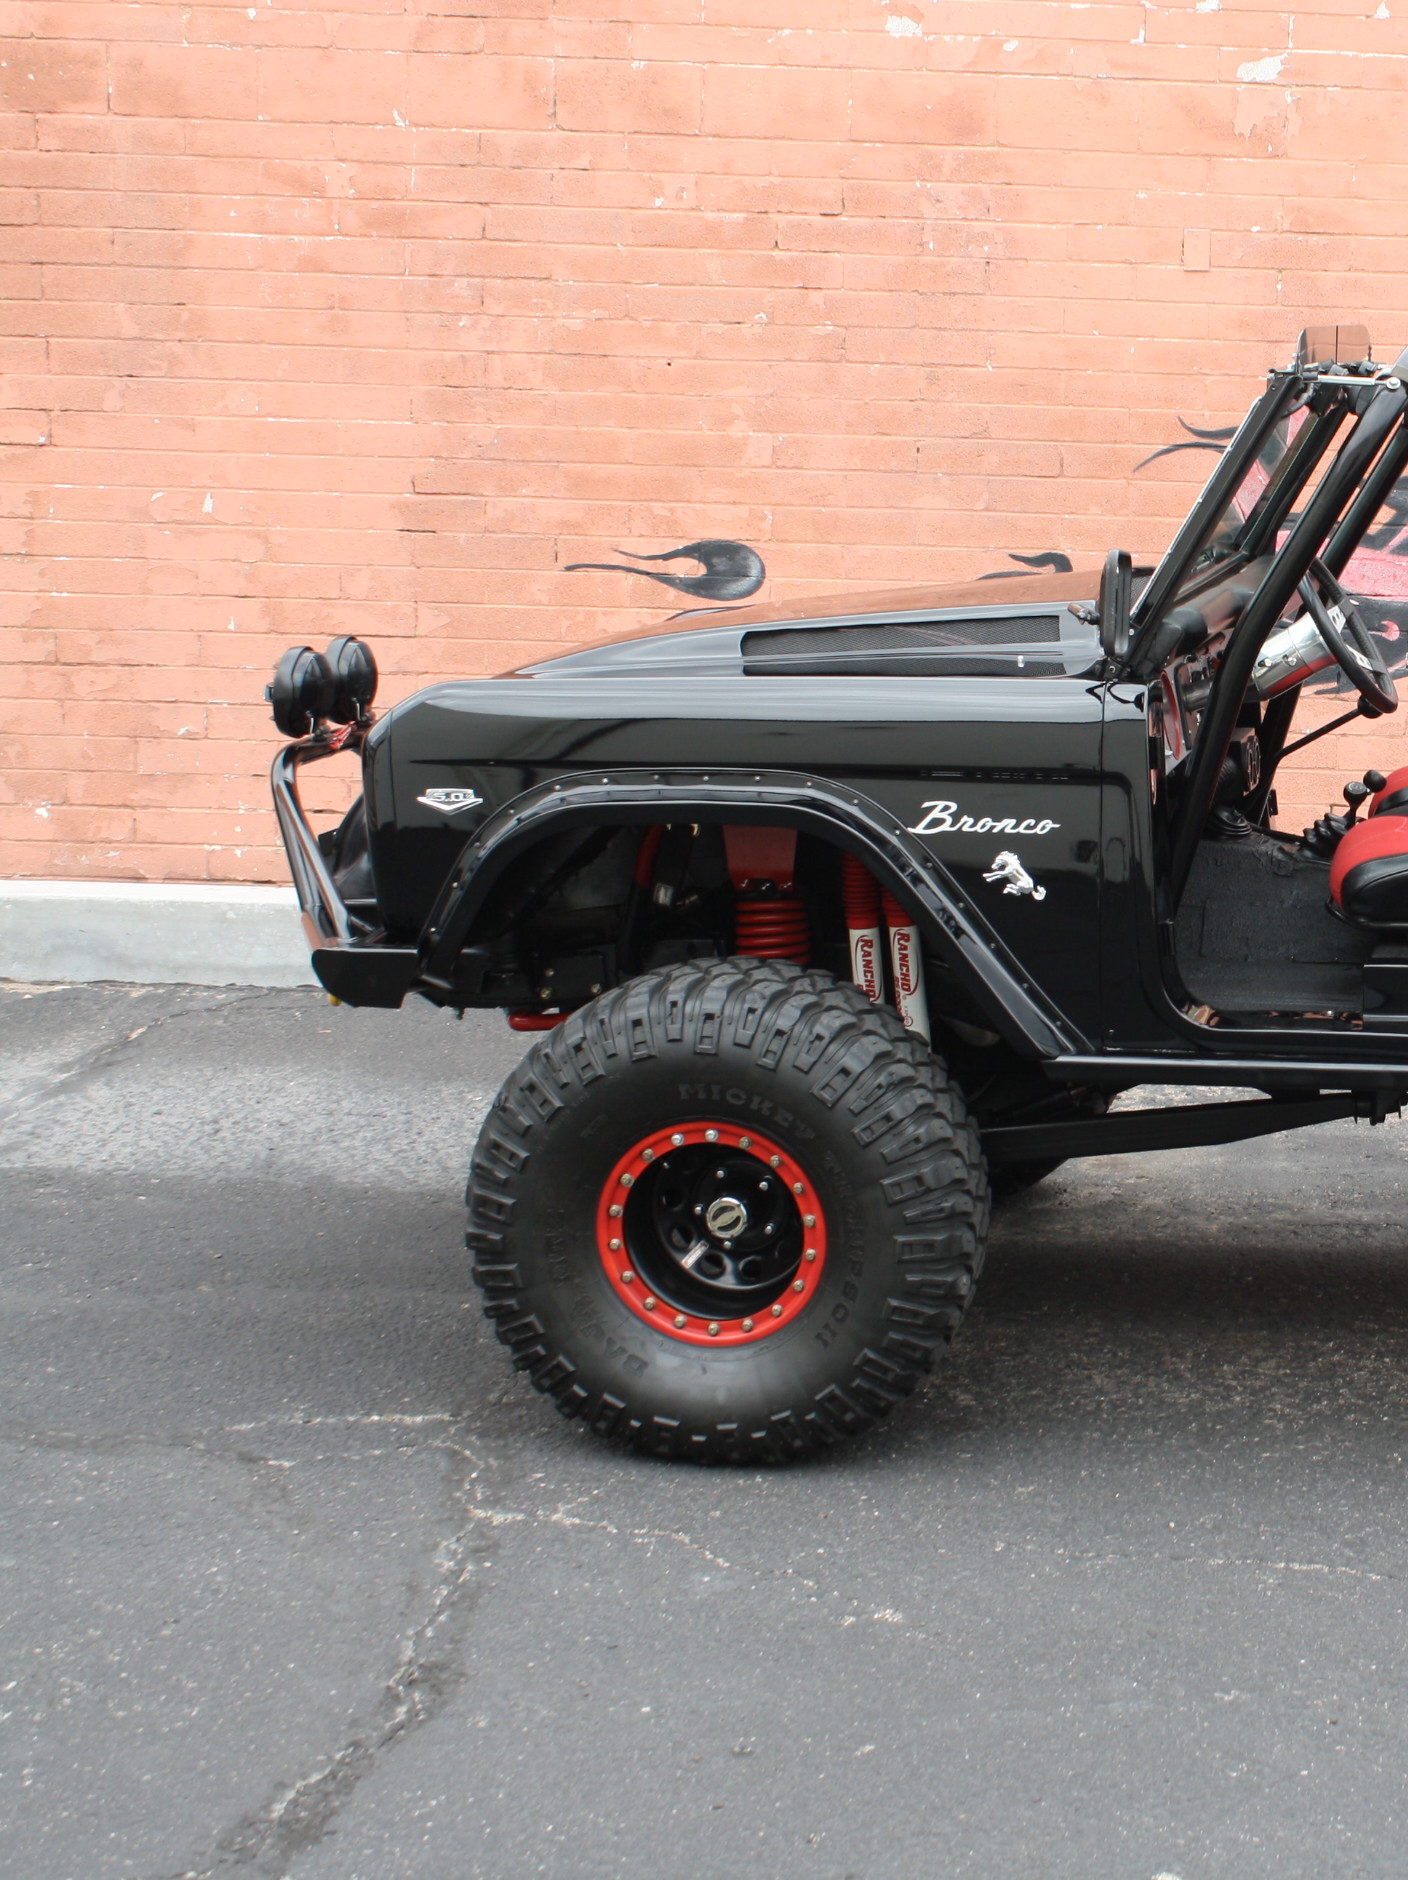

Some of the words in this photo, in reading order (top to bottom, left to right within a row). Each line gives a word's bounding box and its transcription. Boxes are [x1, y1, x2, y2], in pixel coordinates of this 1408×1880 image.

[907, 800, 1062, 835] Bronco
[894, 931, 912, 993] RANCHO
[678, 1082, 816, 1142] MICKEY
